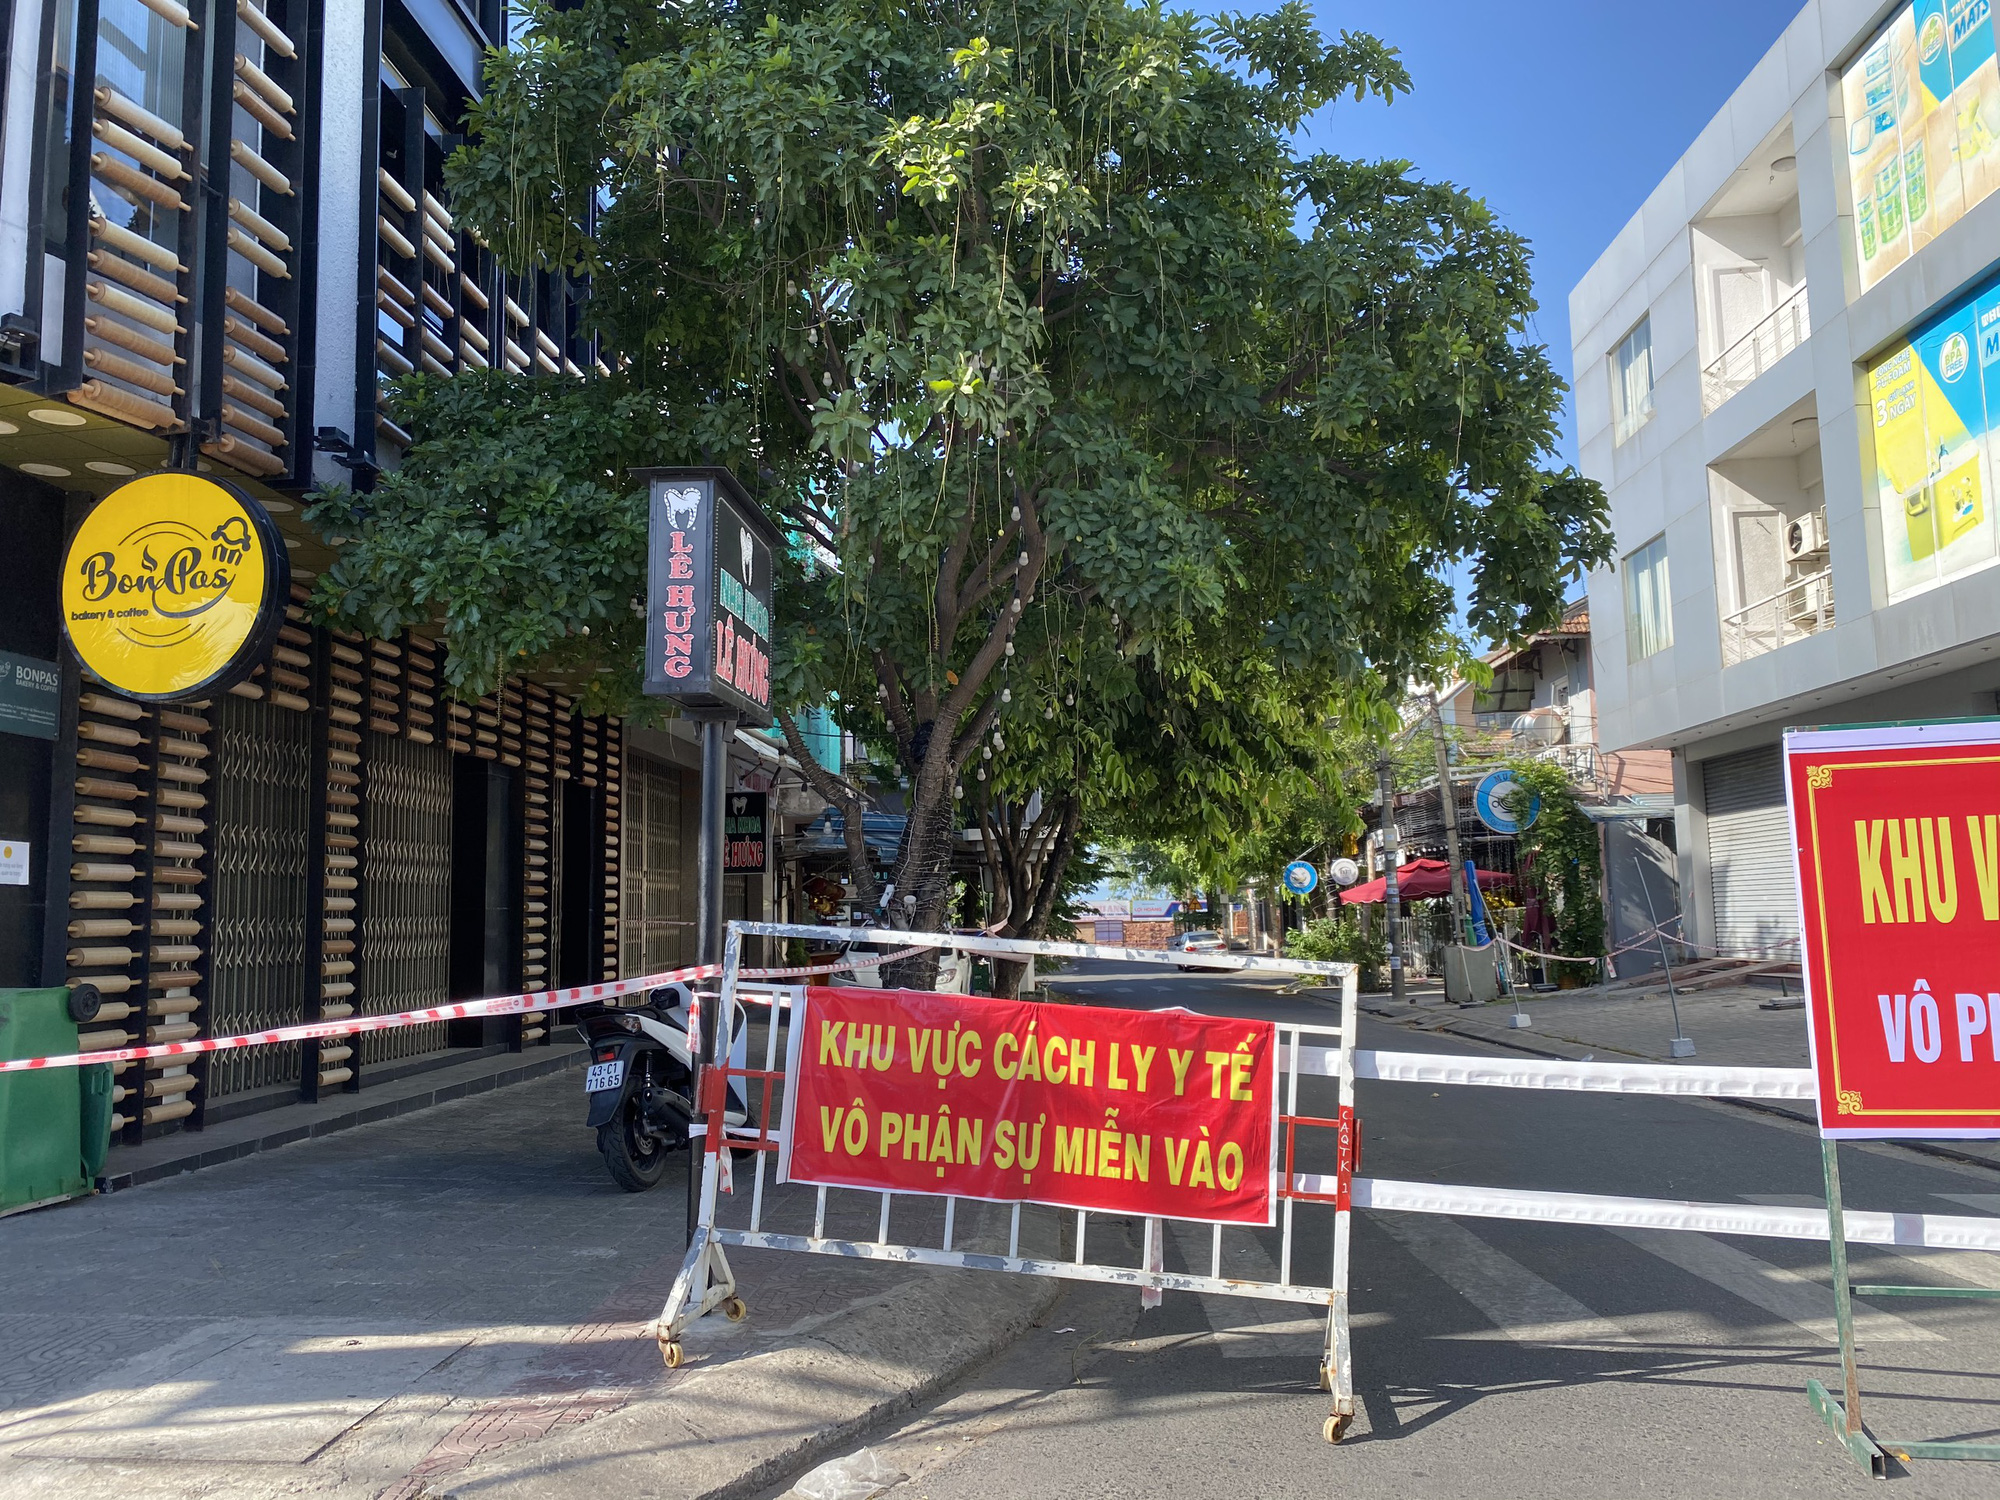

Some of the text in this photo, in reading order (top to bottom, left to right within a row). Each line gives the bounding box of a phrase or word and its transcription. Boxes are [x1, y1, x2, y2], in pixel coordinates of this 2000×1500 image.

[1944, 347, 1962, 365] BPA
[1945, 357, 1964, 375] FREE
[1888, 360, 1911, 385] FOAM
[1876, 399, 1888, 428] 3
[71, 607, 149, 622] bakery & coffee
[15, 678, 35, 689] BAKERY
[40, 684, 58, 693] COFFEE
[16, 665, 58, 686] BONPAS
[738, 816, 762, 834] KHOA
[1854, 814, 2000, 924] KHU V
[1877, 978, 1942, 1064] VÔ
[592, 1062, 618, 1078] 43-C1
[819, 1020, 1257, 1102] KHU VỰC CÁCH LY Y TẾ
[820, 1097, 1244, 1192] VÔ PHẬN SỰ MIỄN VÀO
